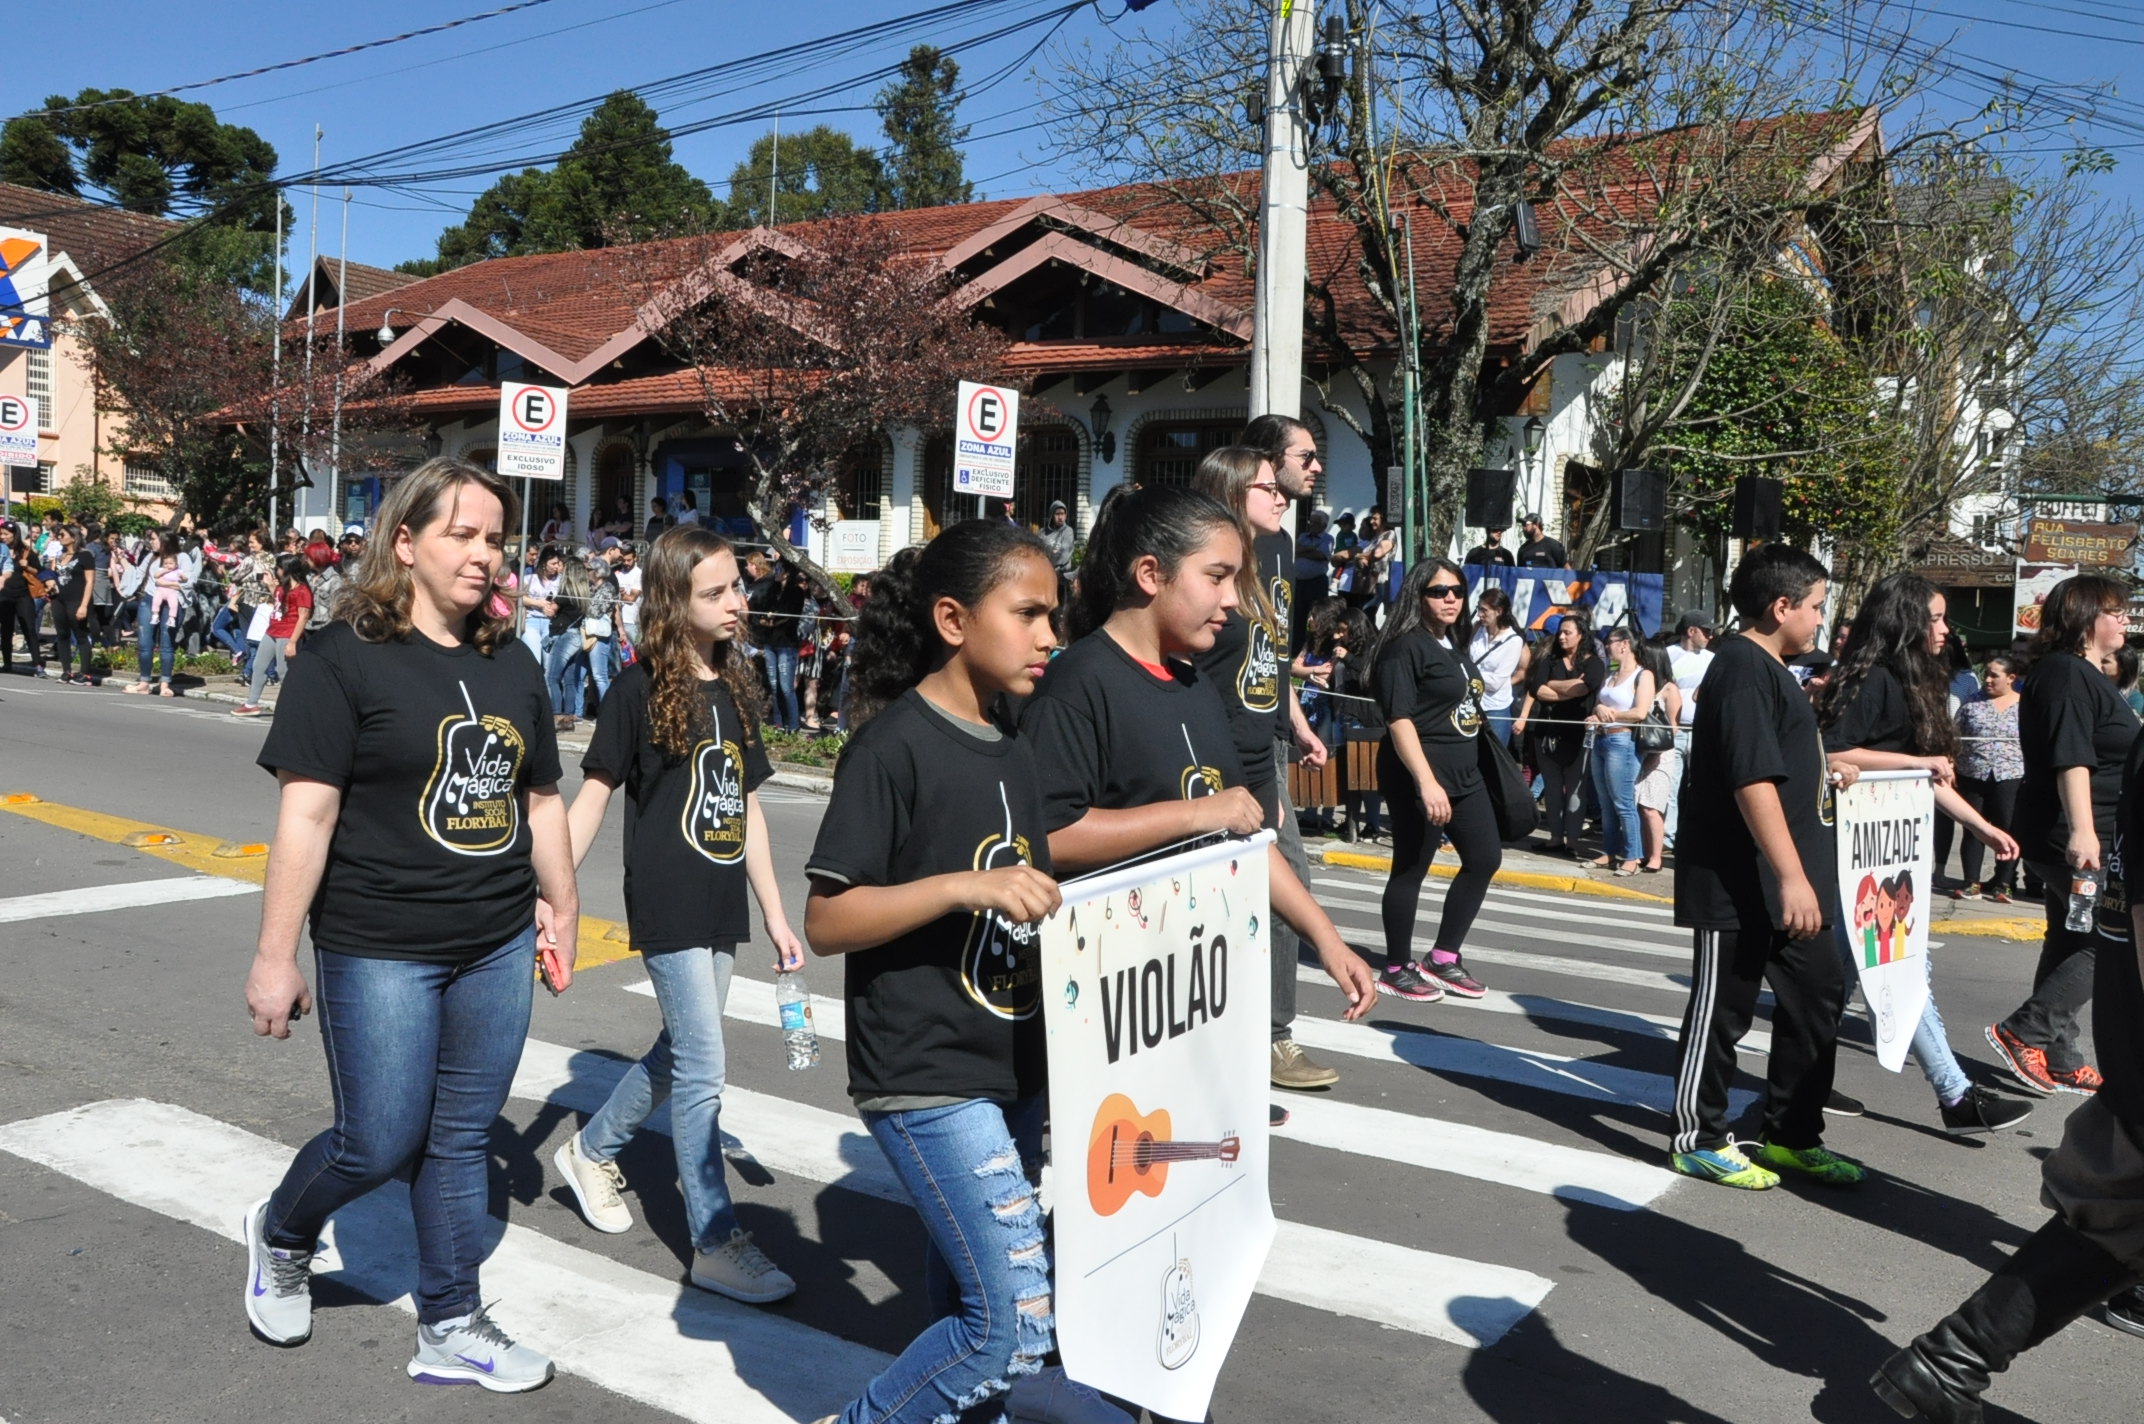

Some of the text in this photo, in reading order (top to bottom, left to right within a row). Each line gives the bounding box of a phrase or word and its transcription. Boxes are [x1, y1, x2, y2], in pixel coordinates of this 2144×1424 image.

[1, 402, 18, 425] E
[525, 395, 544, 424] E
[980, 398, 997, 432] E
[503, 432, 561, 445] ZONA AZUL
[960, 442, 1010, 457] ZONA AZUL
[507, 455, 555, 465] EXCLUSIVO
[517, 463, 544, 471] IDOSO
[971, 475, 1009, 485] DEFICIENTE
[972, 468, 1009, 478] EXCLUSIVO
[2034, 522, 2065, 533] RUA
[842, 533, 867, 543] FOTO
[2031, 535, 2128, 550] FELISBERTO
[2047, 547, 2108, 561] SOARES
[465, 733, 511, 776] Vida
[712, 758, 739, 797] Vida
[446, 772, 514, 815] Mágica
[473, 800, 506, 810] INSTITUTO
[484, 807, 507, 817] SOCIAL
[446, 816, 508, 830] FLORYBAL
[1851, 817, 1921, 870] AMIZADE
[1100, 923, 1228, 1065] VIOLÃO
[1171, 1274, 1190, 1310] Vida
